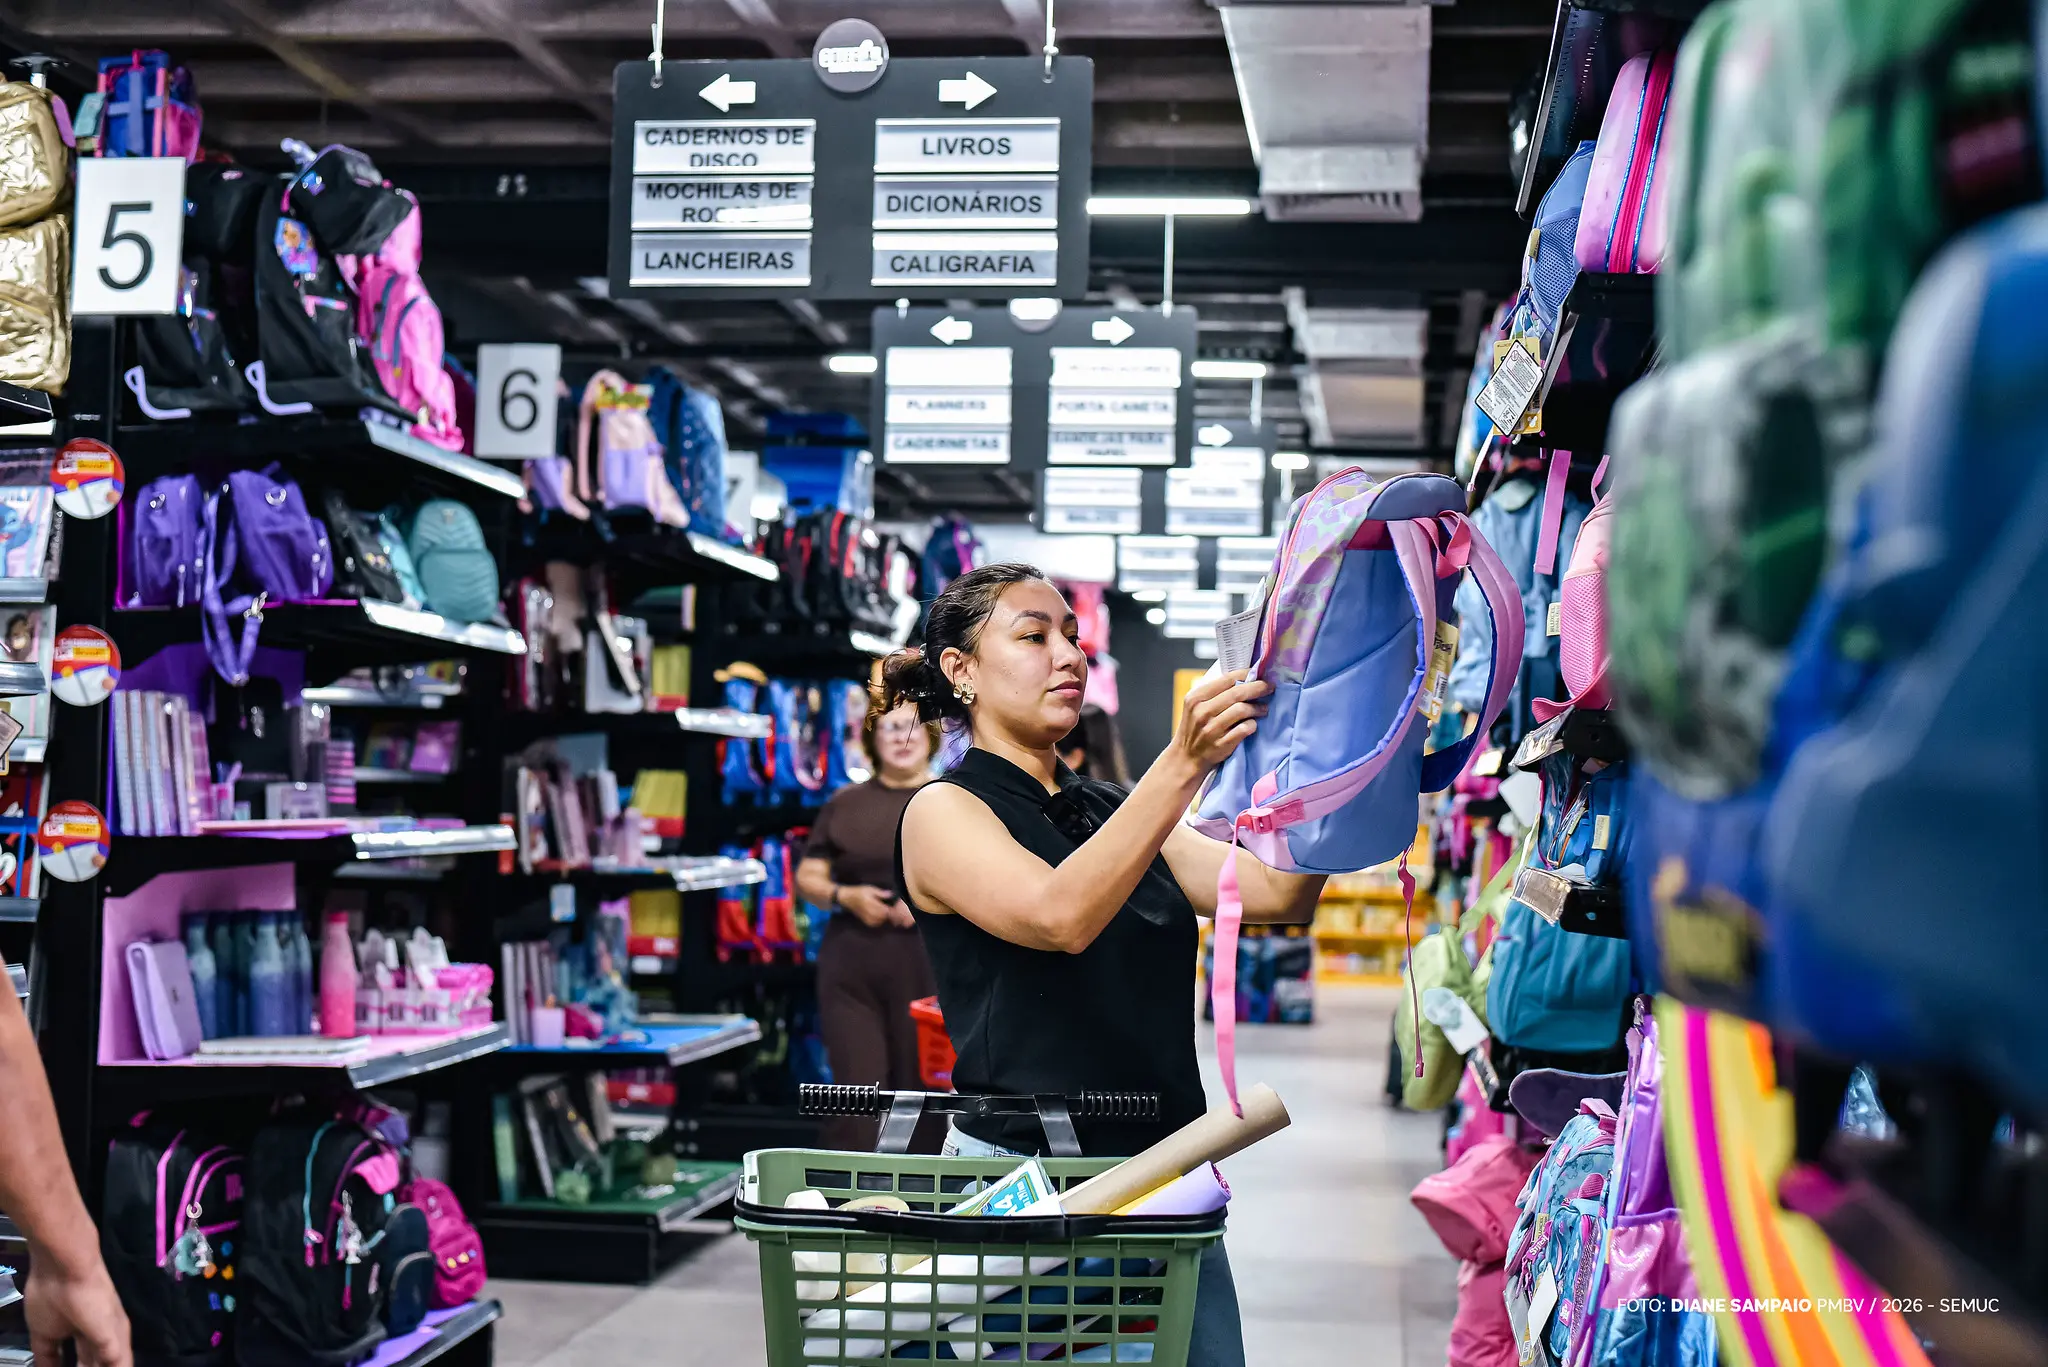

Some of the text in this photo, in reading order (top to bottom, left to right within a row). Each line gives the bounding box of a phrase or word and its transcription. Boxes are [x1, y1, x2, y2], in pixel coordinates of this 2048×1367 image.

[645, 128, 806, 145] CADERNOS DE
[922, 137, 1012, 155] LIVROS
[690, 152, 758, 167] DISCO
[646, 182, 798, 199] MOCHILAS DE
[887, 190, 1043, 213] DICIONÁRIOS
[97, 200, 154, 290] 5
[644, 251, 795, 270] LANCHEIRAS
[890, 255, 1035, 273] CALIGRAFIA
[498, 368, 540, 432] 6
[893, 437, 1000, 450] CADERNETAS
